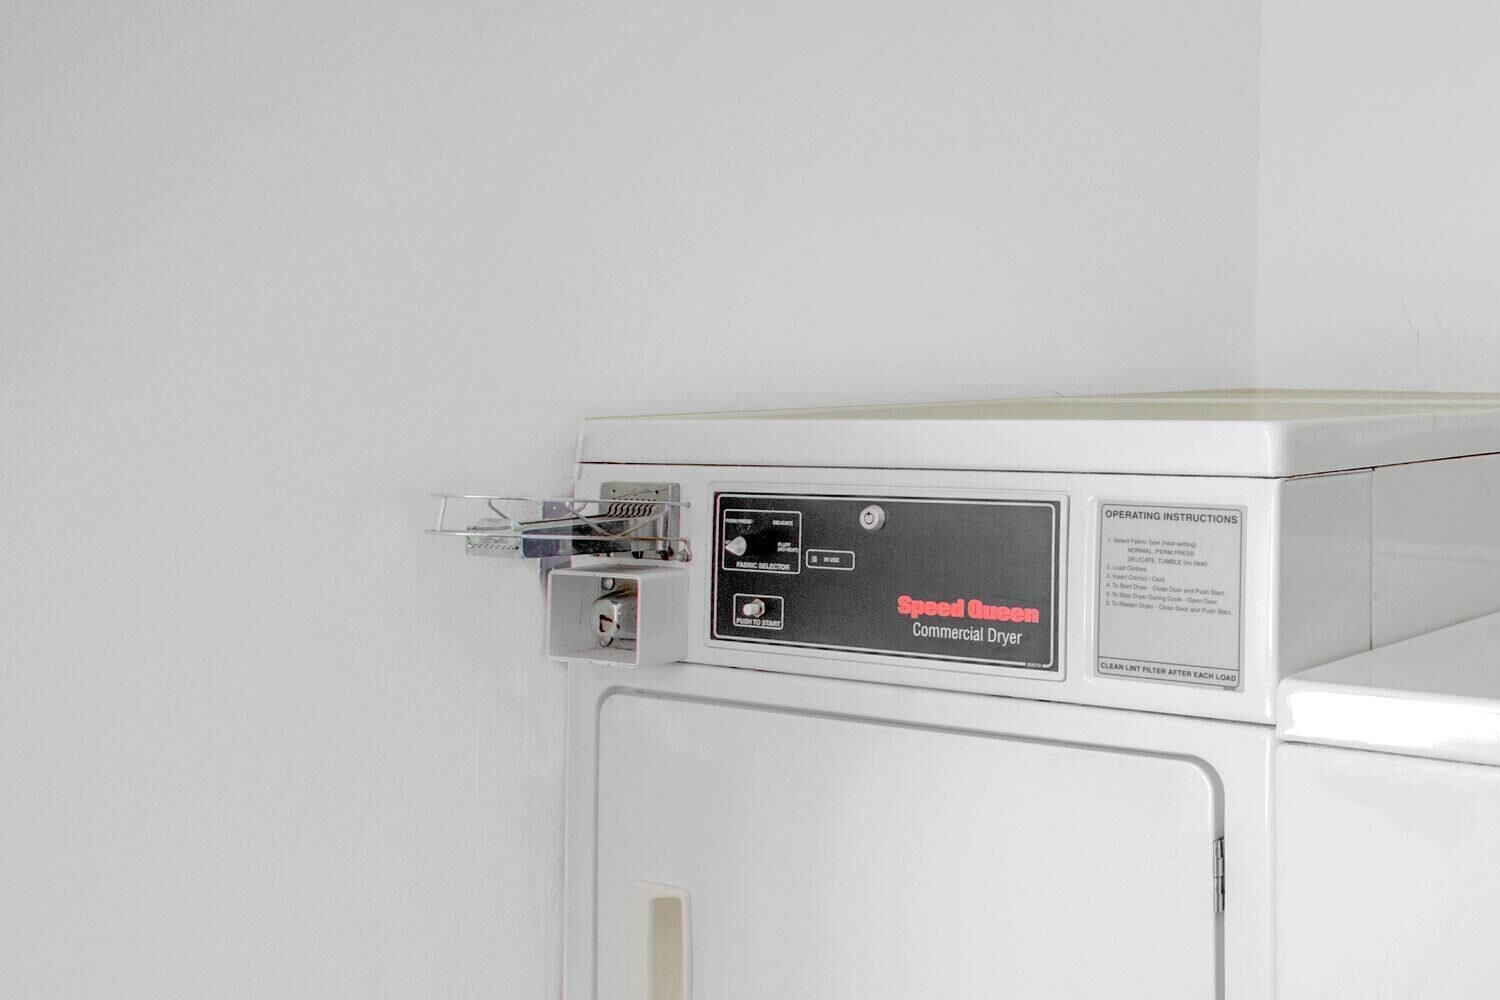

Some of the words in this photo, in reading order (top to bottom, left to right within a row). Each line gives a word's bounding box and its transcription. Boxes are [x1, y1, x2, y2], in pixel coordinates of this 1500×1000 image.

[1105, 509, 1160, 521] OPERATING
[1163, 512, 1238, 524] INSTRUCTIONS
[758, 562, 790, 571] SELECTOR
[1148, 594, 1166, 602] During
[897, 594, 965, 618] Speed
[967, 599, 1040, 624] Queen
[736, 617, 752, 625] PUSH
[912, 621, 984, 642] Commercial
[988, 627, 1022, 647] Dryer
[1100, 661, 1124, 671] CLEAN
[1125, 664, 1140, 673] LINT
[1142, 666, 1166, 676] FILTER
[1168, 668, 1192, 678] AFTER
[1194, 671, 1215, 680] EACH
[1216, 674, 1237, 682] LOAD
